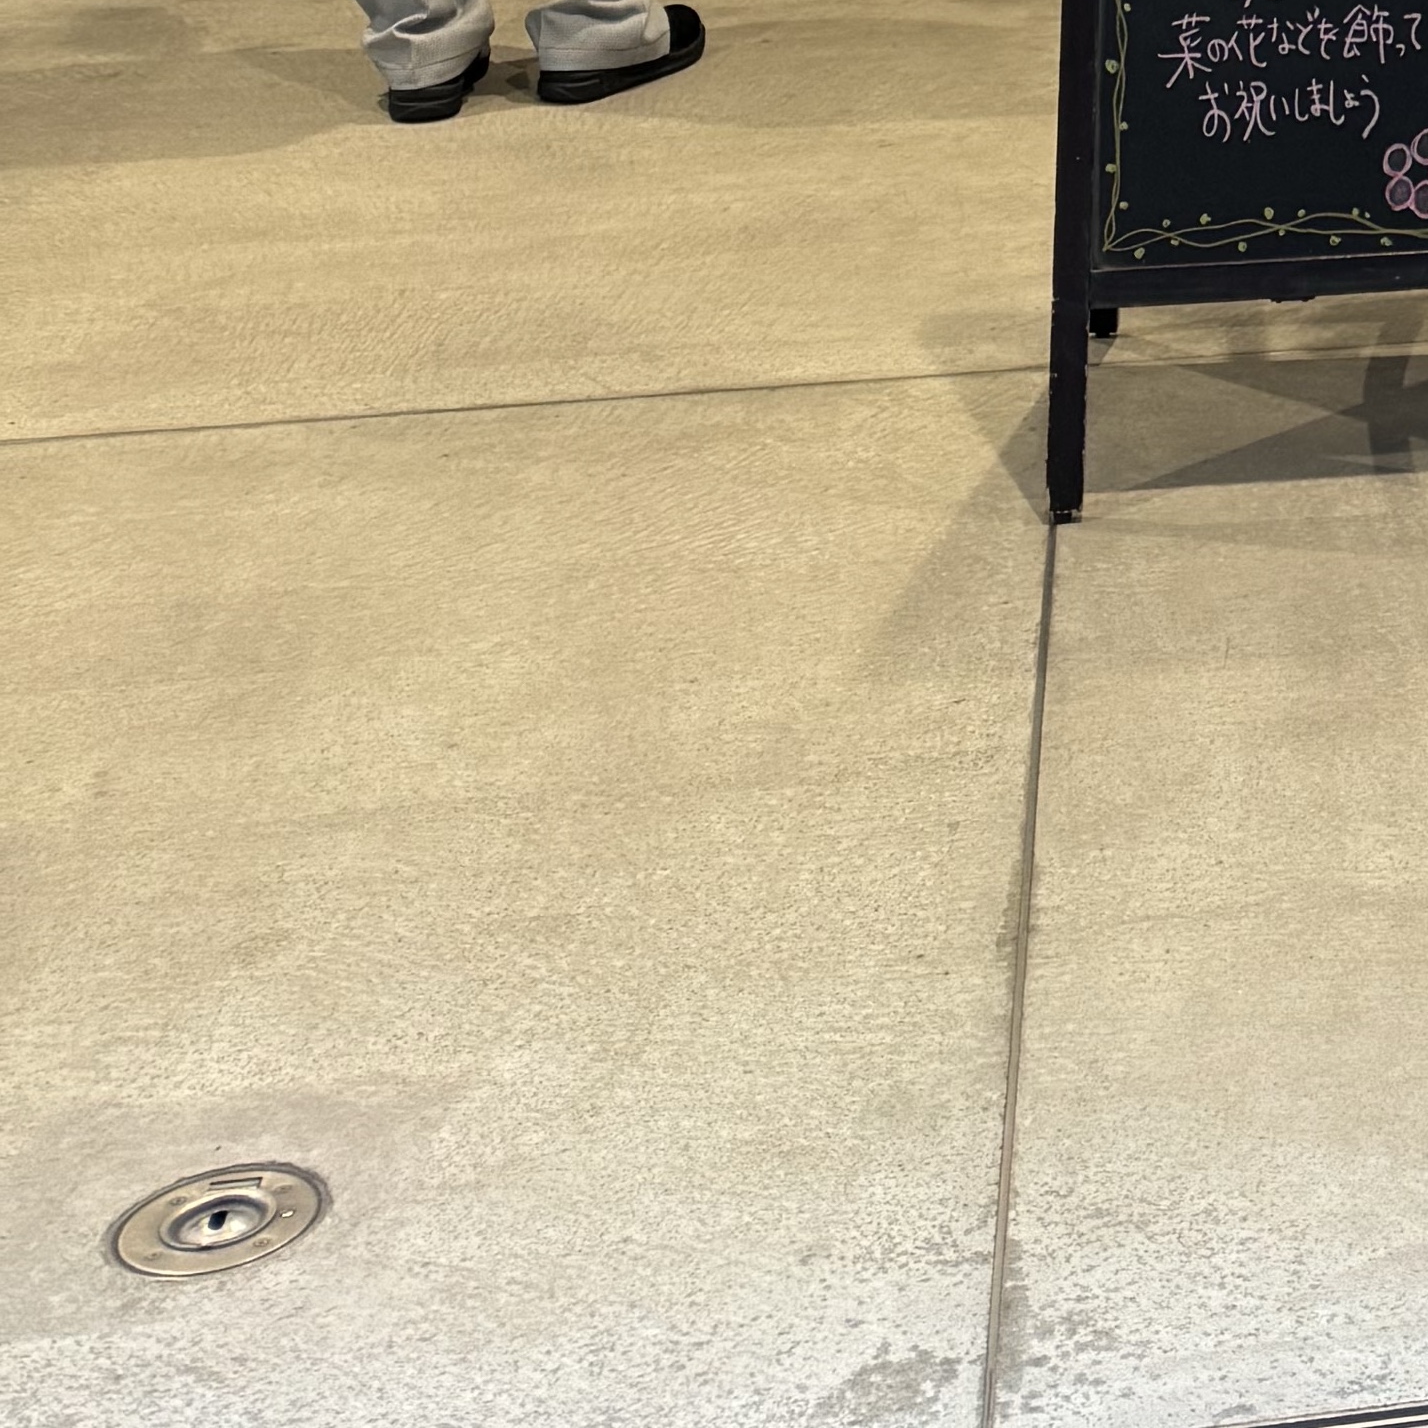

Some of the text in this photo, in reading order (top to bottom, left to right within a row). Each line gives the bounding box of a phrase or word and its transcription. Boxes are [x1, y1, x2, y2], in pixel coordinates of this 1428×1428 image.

[1158, 4, 1422, 88] 菜の花などを飾って
[1199, 75, 1380, 142] お祝いしましょう
